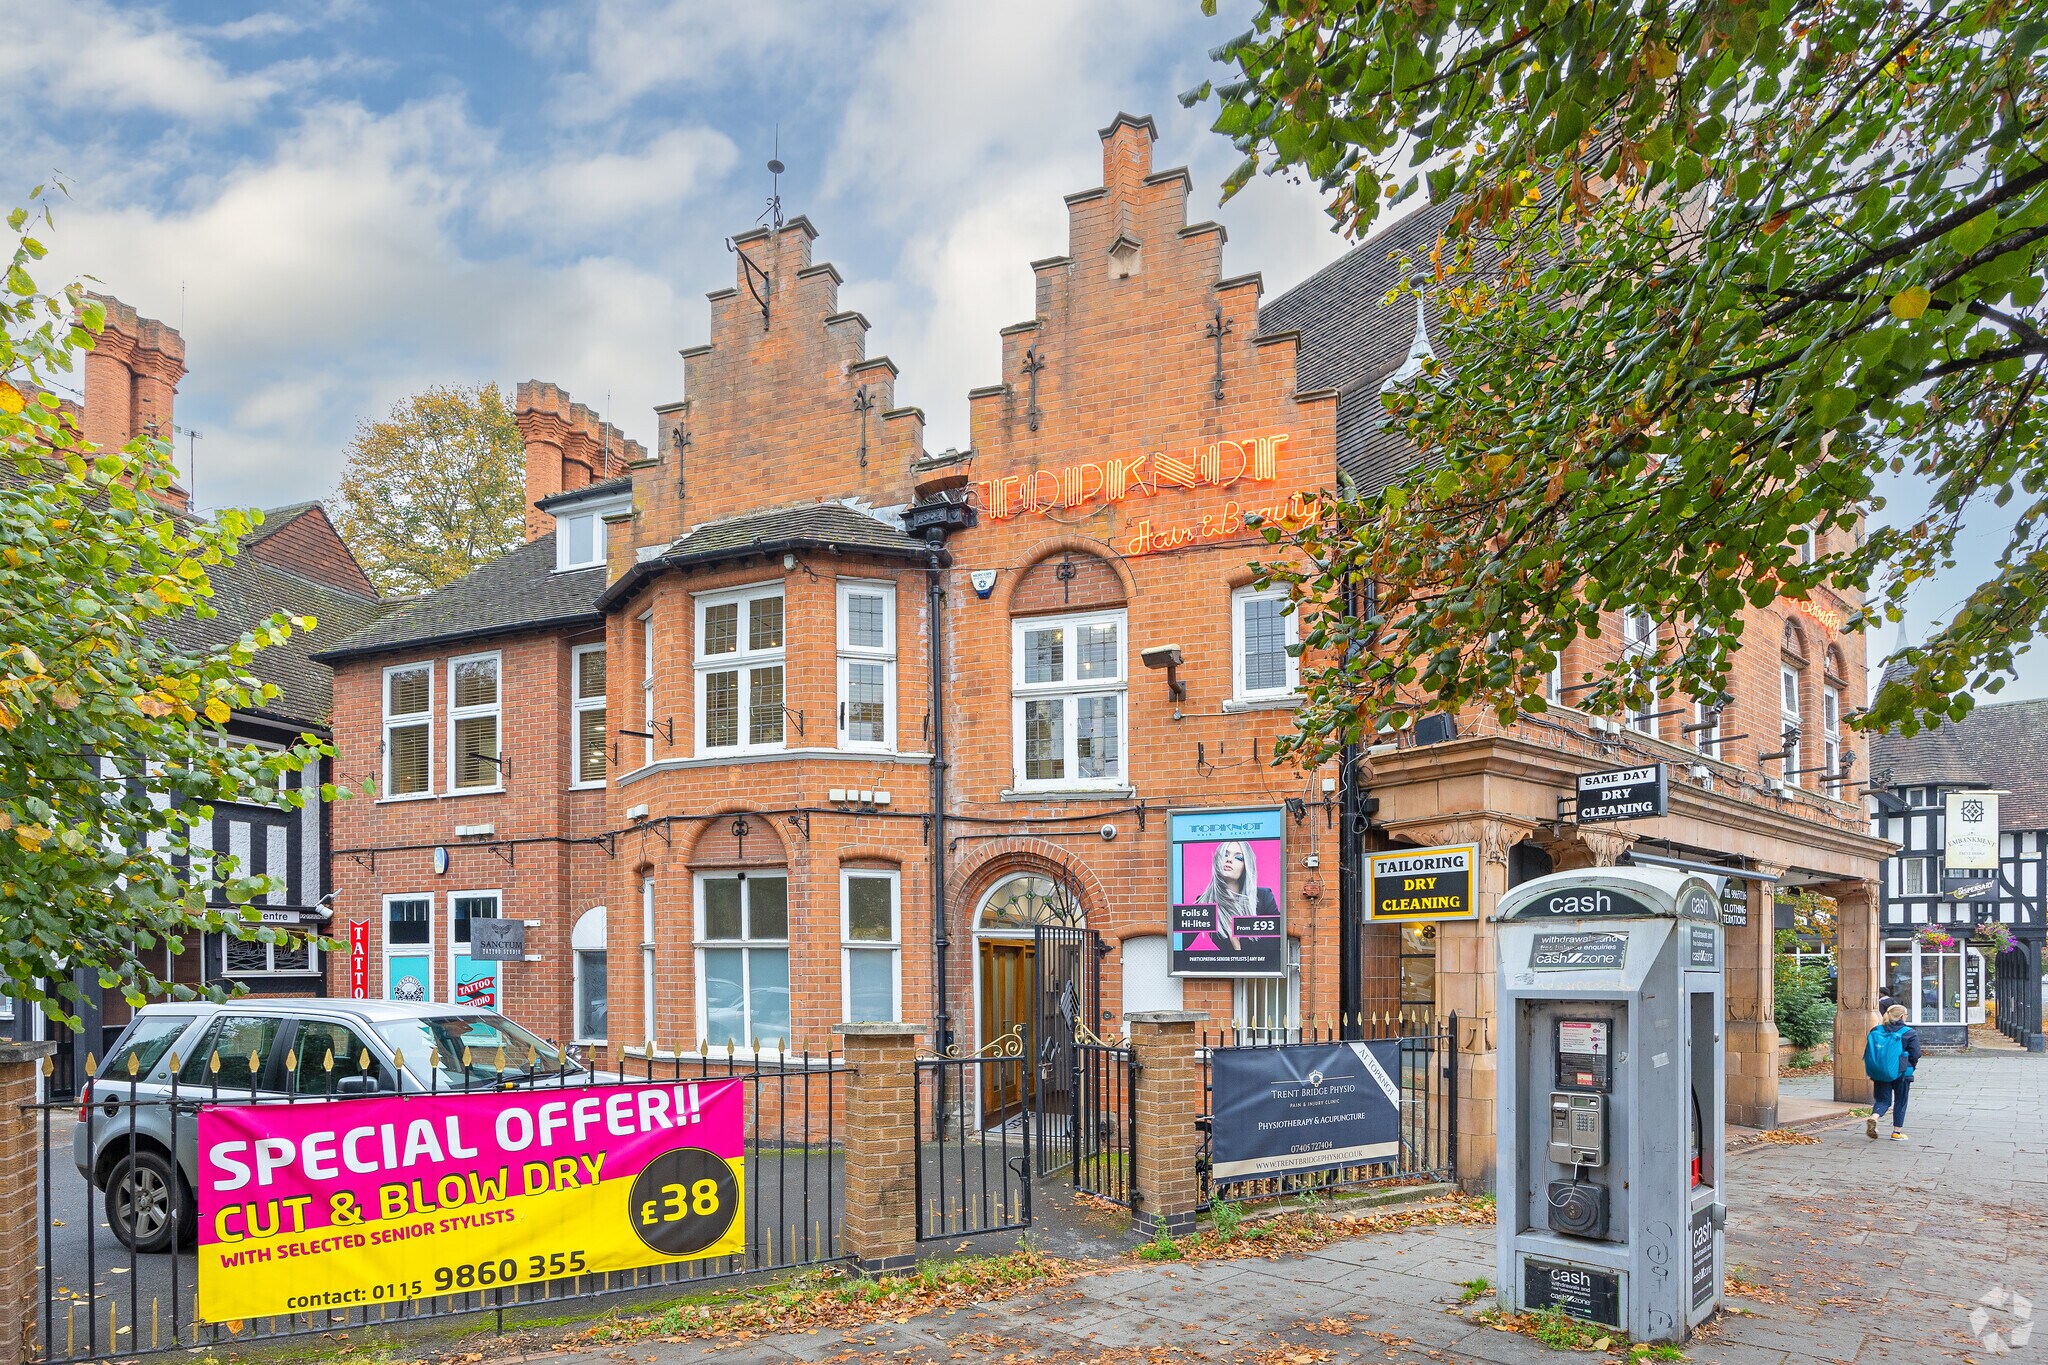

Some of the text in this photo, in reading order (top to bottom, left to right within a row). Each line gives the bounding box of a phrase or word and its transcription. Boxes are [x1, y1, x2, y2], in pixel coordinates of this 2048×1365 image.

[980, 434, 1289, 519] TOPKNOT
[1128, 519, 1194, 556] Hair
[1585, 769, 1649, 786] SAME DAY
[1601, 788, 1632, 801] DRY
[1581, 801, 1653, 818] CLEANING
[1189, 822, 1263, 833] TOPKNOT
[1947, 836, 1996, 848] EMBANKMENT
[1377, 855, 1465, 874] TAILORING
[1403, 877, 1436, 891] DRY
[1381, 896, 1461, 912] CLEANING
[1549, 891, 1611, 914] cash
[1691, 894, 1709, 915] cash
[1723, 903, 1747, 914] CLOTHING
[263, 912, 288, 921] entre
[1181, 908, 1209, 918] Foils &
[1181, 919, 1211, 928] Hi-lites
[1252, 920, 1275, 931] £93
[480, 941, 523, 949] SANCTUM
[1583, 943, 1617, 951] enquiries
[353, 926, 365, 999] TATTO
[459, 979, 490, 995] TATTOO
[1358, 1048, 1395, 1097] AT TOPKNOT
[1270, 1084, 1356, 1099] TRENT BRIDGE PHYSIO
[1258, 1112, 1366, 1130] PHYSIOTHERAPY & ACUPUNCTURE
[209, 1083, 701, 1191] SPECIAL OFFER!!
[1290, 1140, 1333, 1153] 07405 727404
[213, 1150, 608, 1244] CUT & BLOW DRY
[640, 1178, 720, 1226] £38
[220, 1209, 515, 1269] WITH SELECTED SENIOR STYLISTS
[1693, 1217, 1712, 1249] cash
[287, 1250, 586, 1309] contact: 0115 9860 355
[1550, 1269, 1591, 1287] cash
